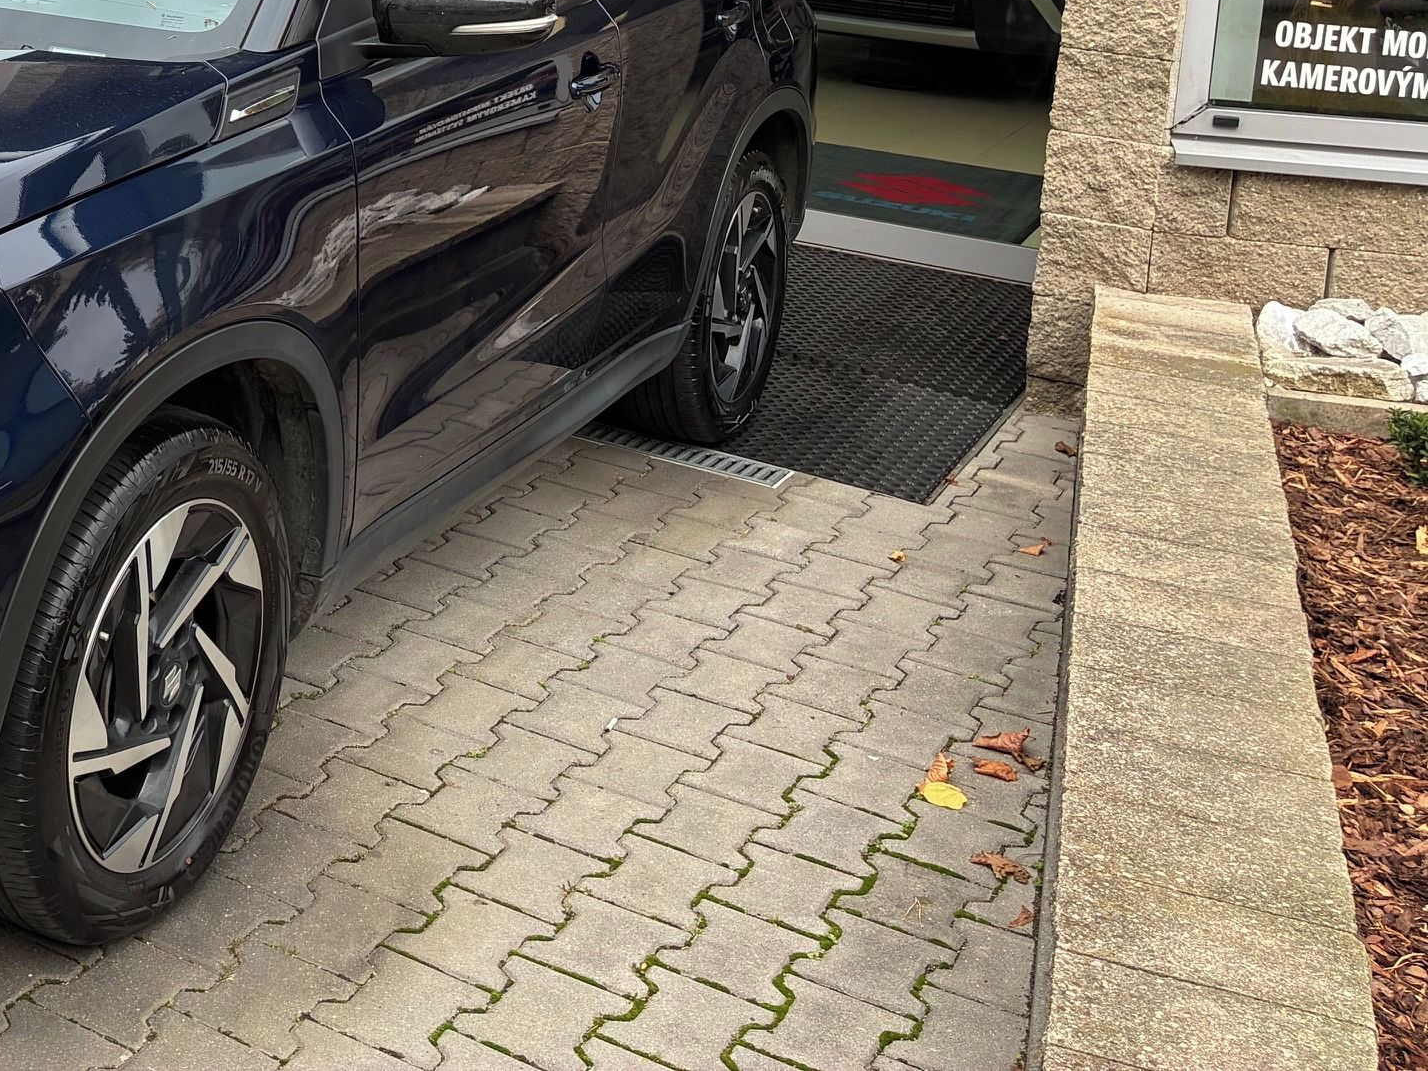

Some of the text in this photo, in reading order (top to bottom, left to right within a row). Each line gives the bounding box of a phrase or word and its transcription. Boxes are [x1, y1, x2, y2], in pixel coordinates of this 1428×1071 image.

[1275, 20, 1376, 55] OBJEKT
[1382, 29, 1428, 59] MO
[208, 458, 238, 477] 215/55
